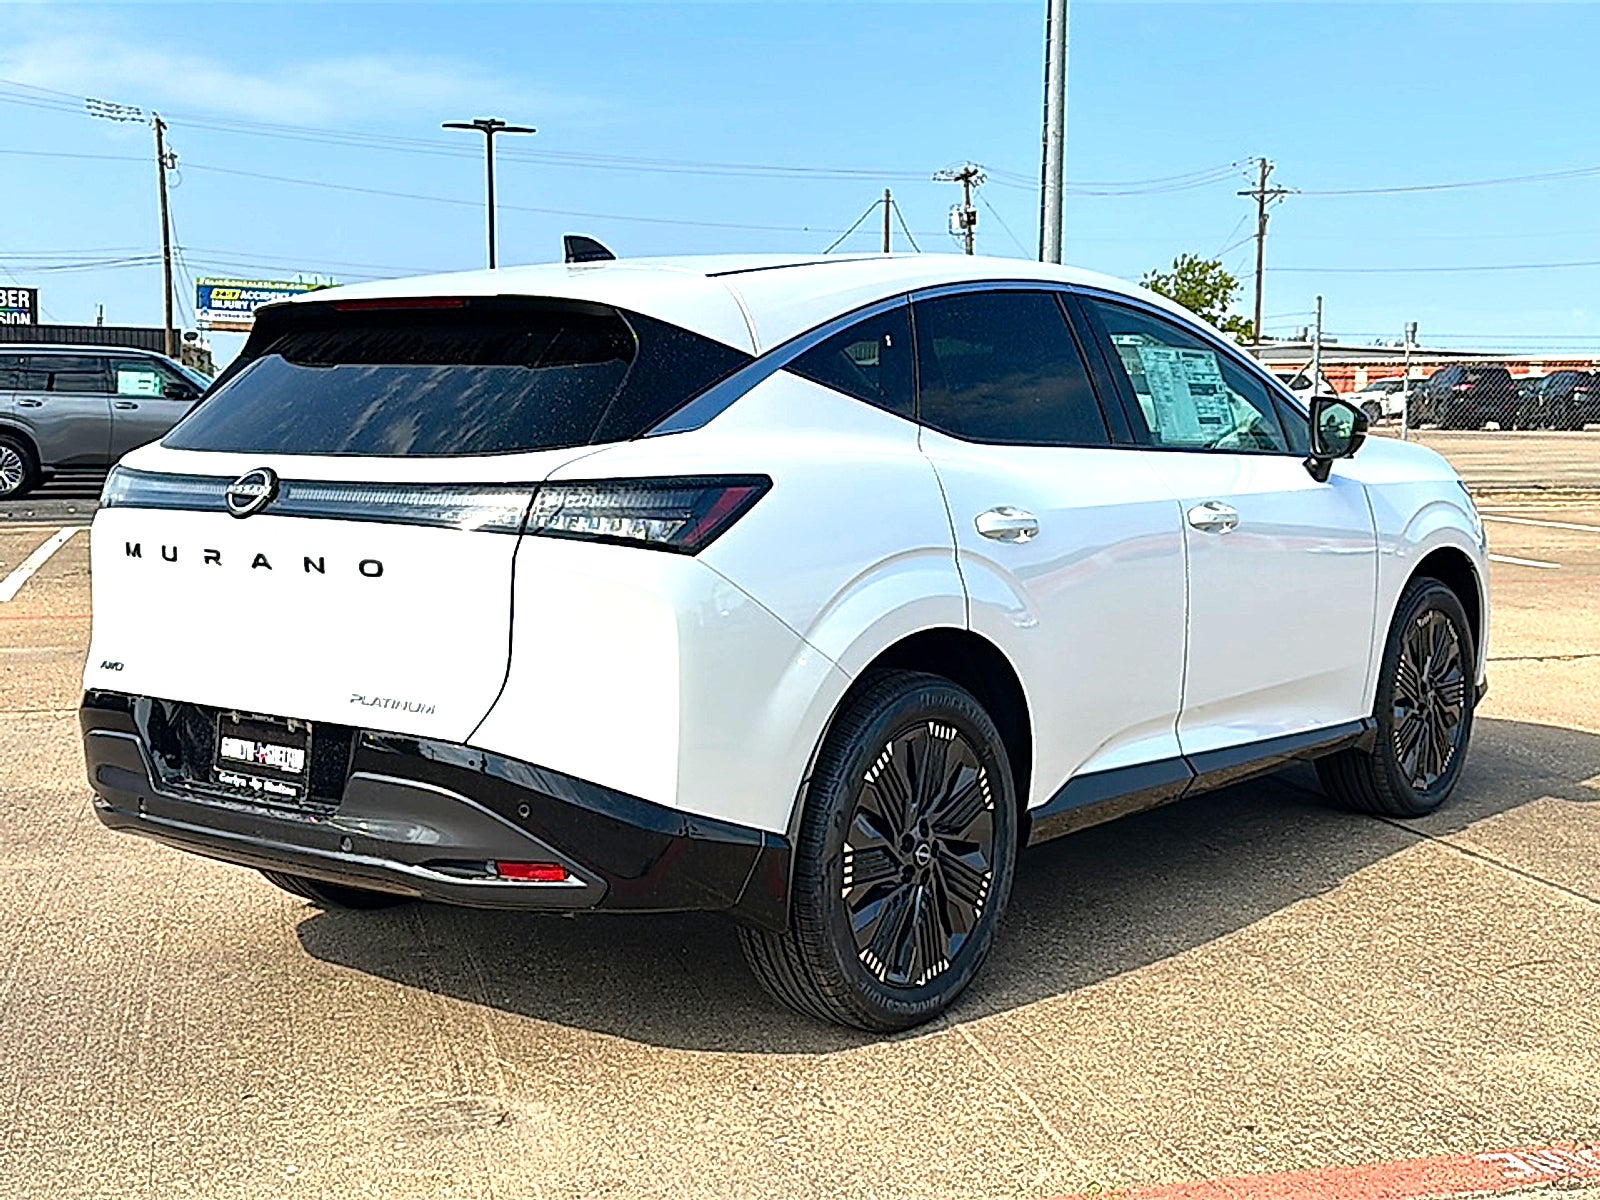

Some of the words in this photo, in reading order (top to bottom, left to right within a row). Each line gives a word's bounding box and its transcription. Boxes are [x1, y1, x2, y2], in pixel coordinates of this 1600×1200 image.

[125, 541, 384, 578] MURANO
[99, 660, 125, 672] AWD
[349, 693, 436, 715] PLATINUM
